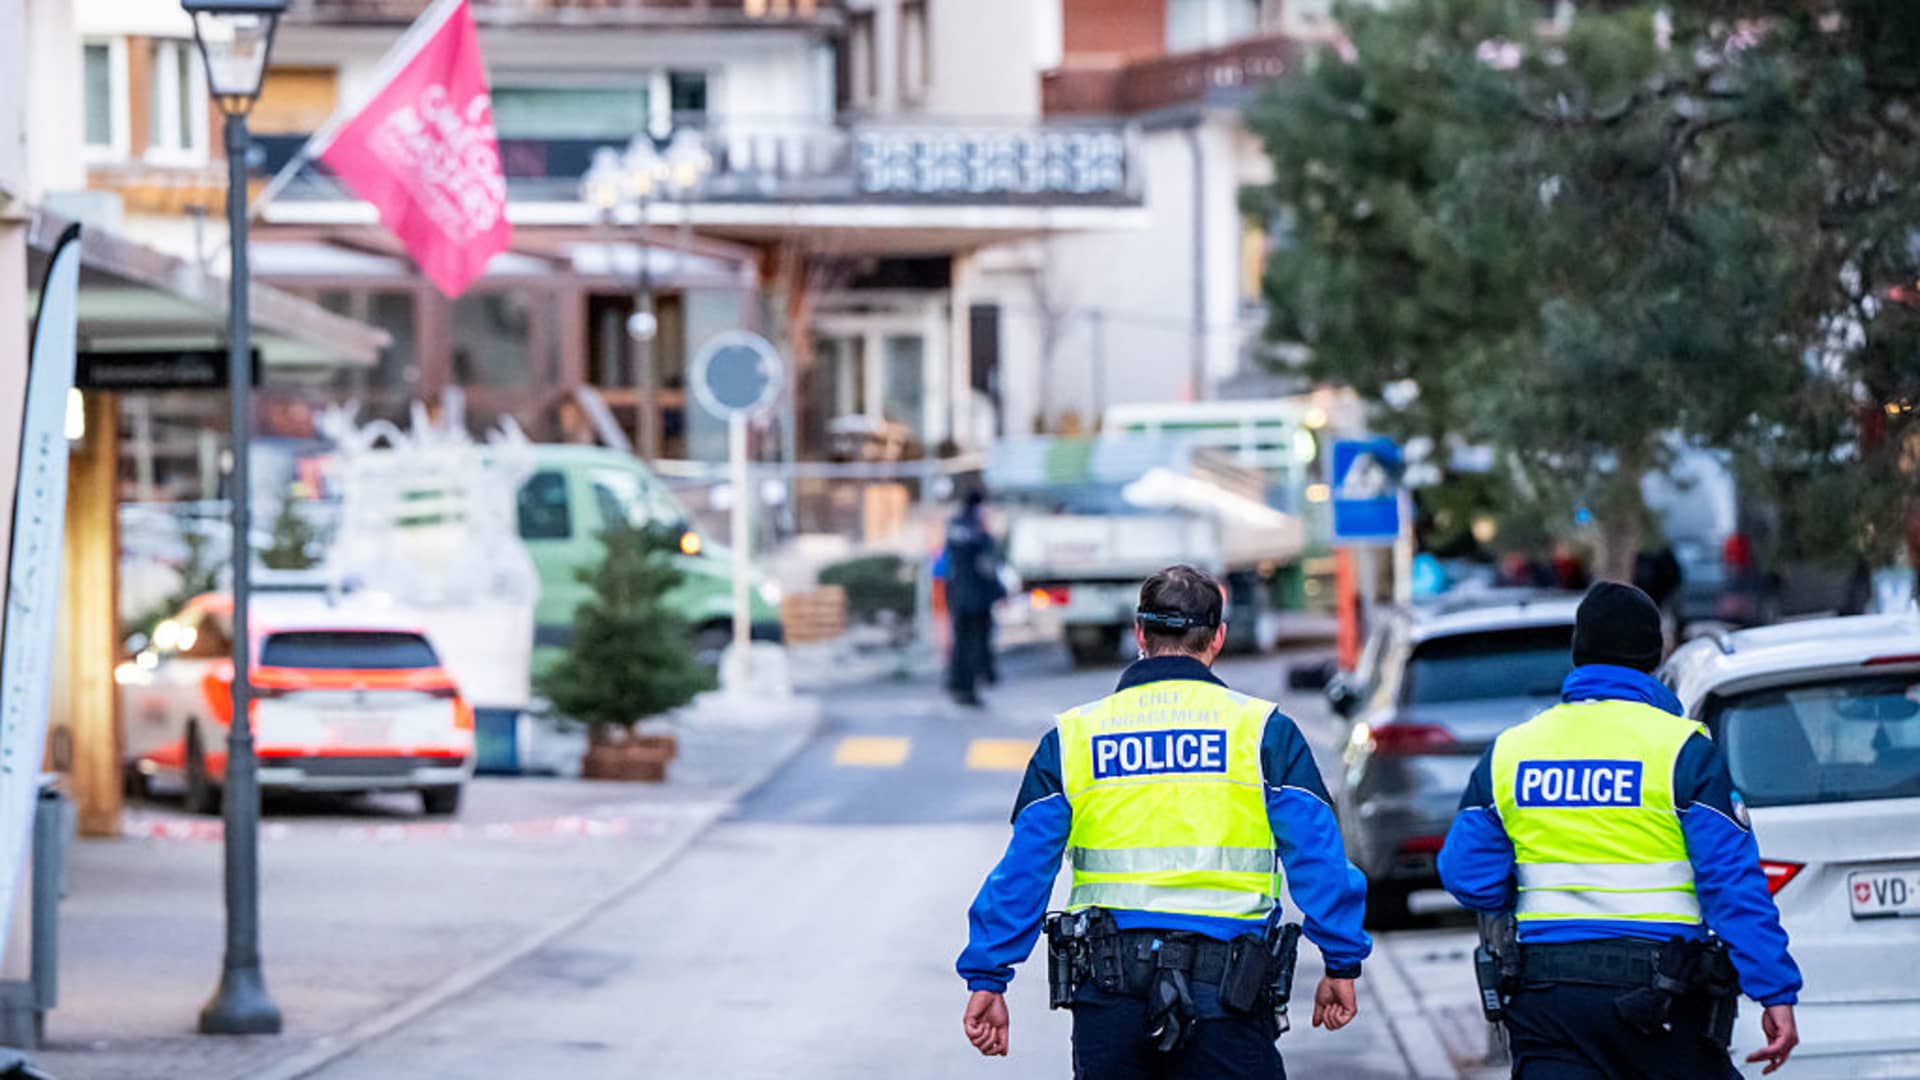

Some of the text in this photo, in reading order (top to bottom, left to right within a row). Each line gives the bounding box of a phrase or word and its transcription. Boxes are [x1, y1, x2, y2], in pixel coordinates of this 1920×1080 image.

[1140, 692, 1179, 707] CHEF
[1101, 710, 1219, 729] ENGAGEMENT
[1097, 733, 1221, 774] POLICE
[1522, 767, 1634, 803] POLICE
